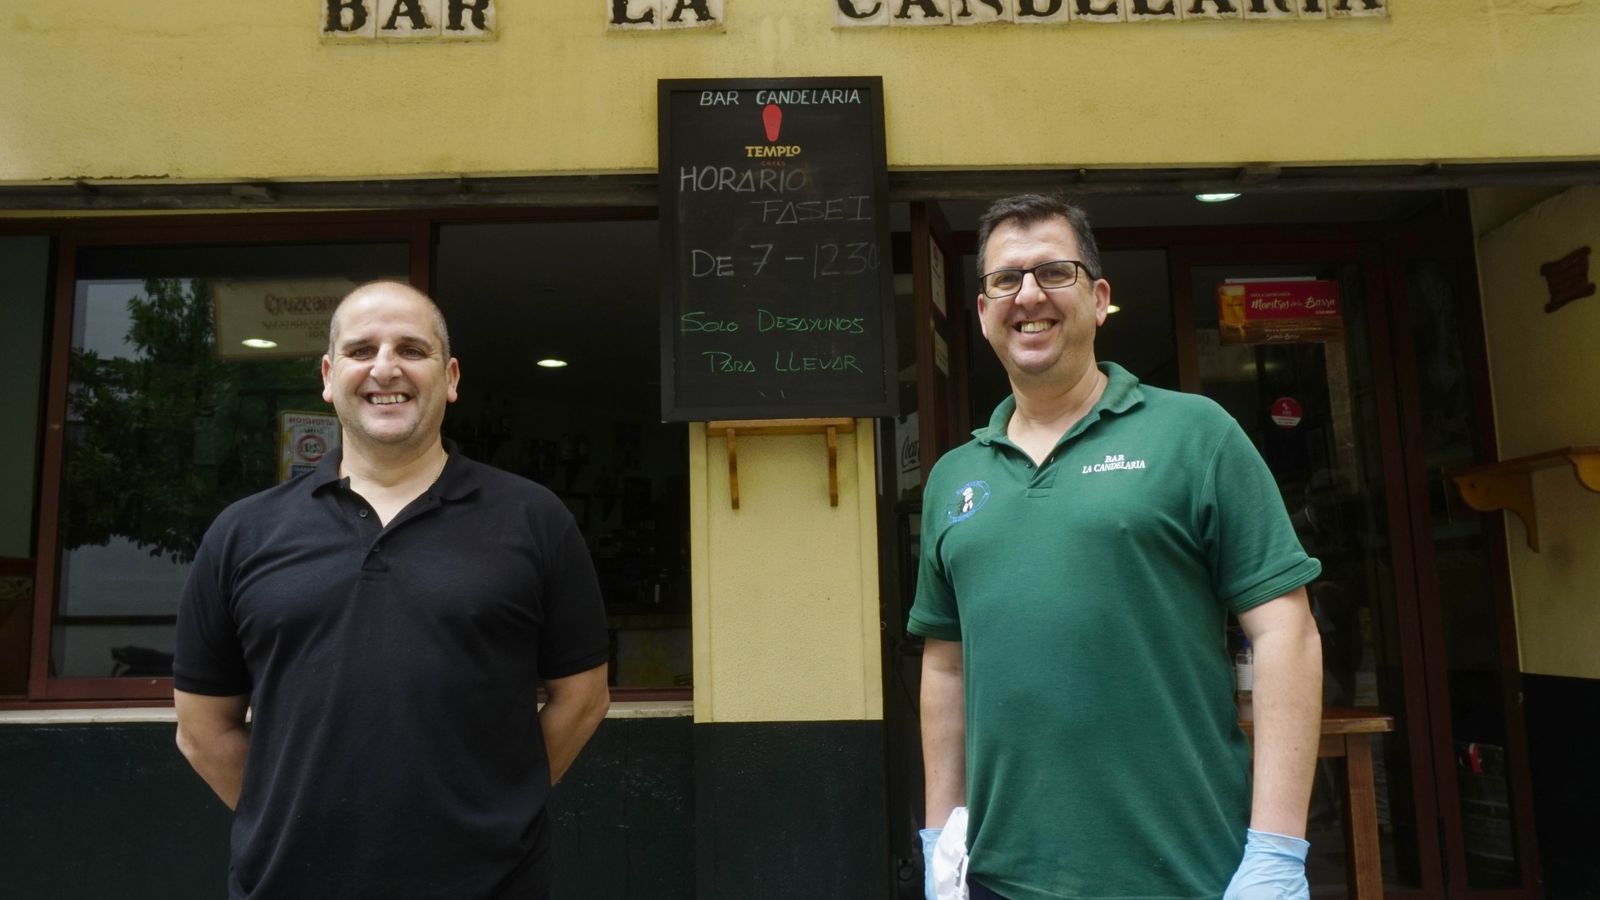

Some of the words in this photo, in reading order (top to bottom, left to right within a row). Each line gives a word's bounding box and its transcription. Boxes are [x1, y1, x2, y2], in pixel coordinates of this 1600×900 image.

[699, 90, 740, 107] BAR
[756, 88, 862, 106] CANDELARIA
[745, 145, 802, 158] TEMPLO
[680, 165, 808, 194] HORARIO
[691, 248, 735, 278] DE
[750, 243, 774, 276] 7
[264, 292, 341, 315] Cruzcam
[680, 311, 739, 333] SOLO
[757, 308, 865, 334] DESAYUNOS
[701, 351, 756, 374] PARA
[775, 351, 864, 374] LLEVAR
[1082, 465, 1093, 474] LA
[1093, 460, 1146, 473] CANDELARIA
[1104, 454, 1125, 463] BAR
